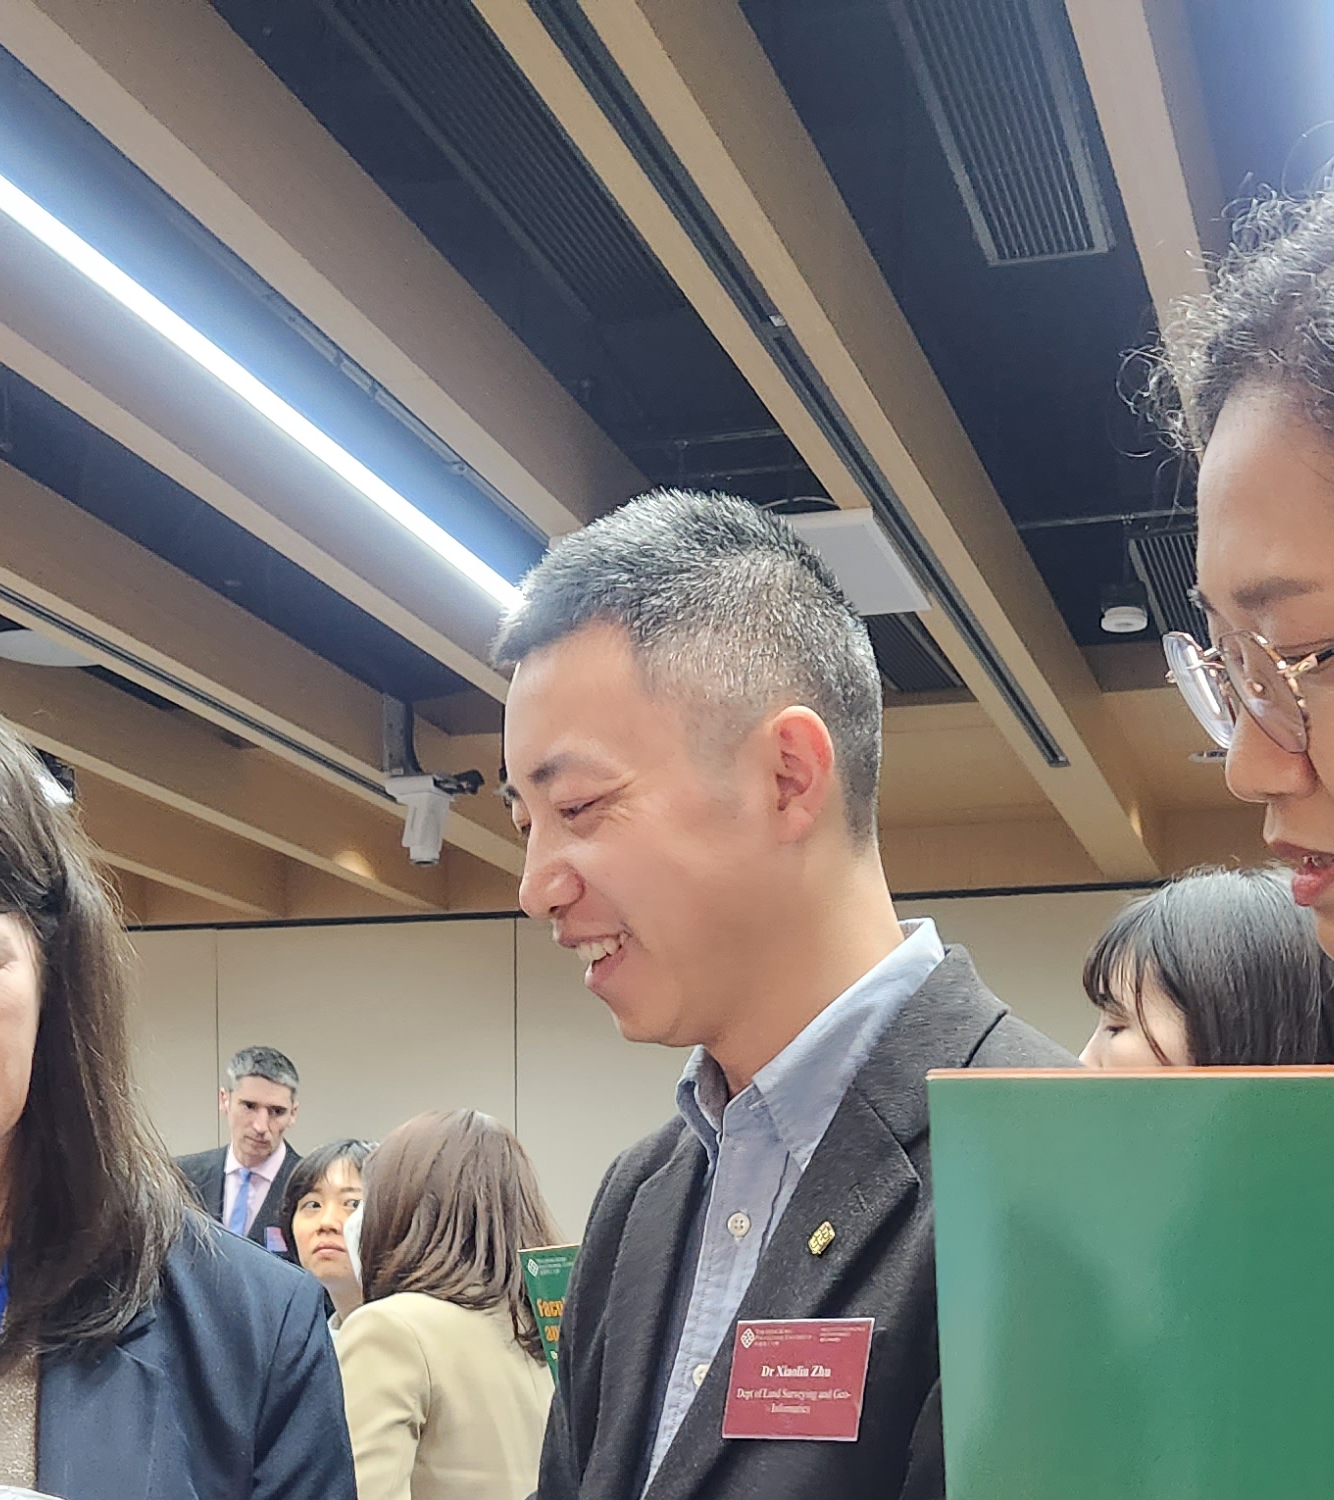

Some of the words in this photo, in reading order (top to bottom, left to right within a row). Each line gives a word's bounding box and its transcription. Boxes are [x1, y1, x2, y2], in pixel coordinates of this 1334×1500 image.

[760, 1365, 775, 1377] Dr
[776, 1365, 809, 1377] Xiaolin
[810, 1365, 832, 1377] Zhu
[736, 1388, 754, 1400] Dept
[754, 1389, 763, 1398] of
[763, 1389, 782, 1398] Land
[782, 1389, 818, 1401] Surveying
[818, 1390, 832, 1398] and
